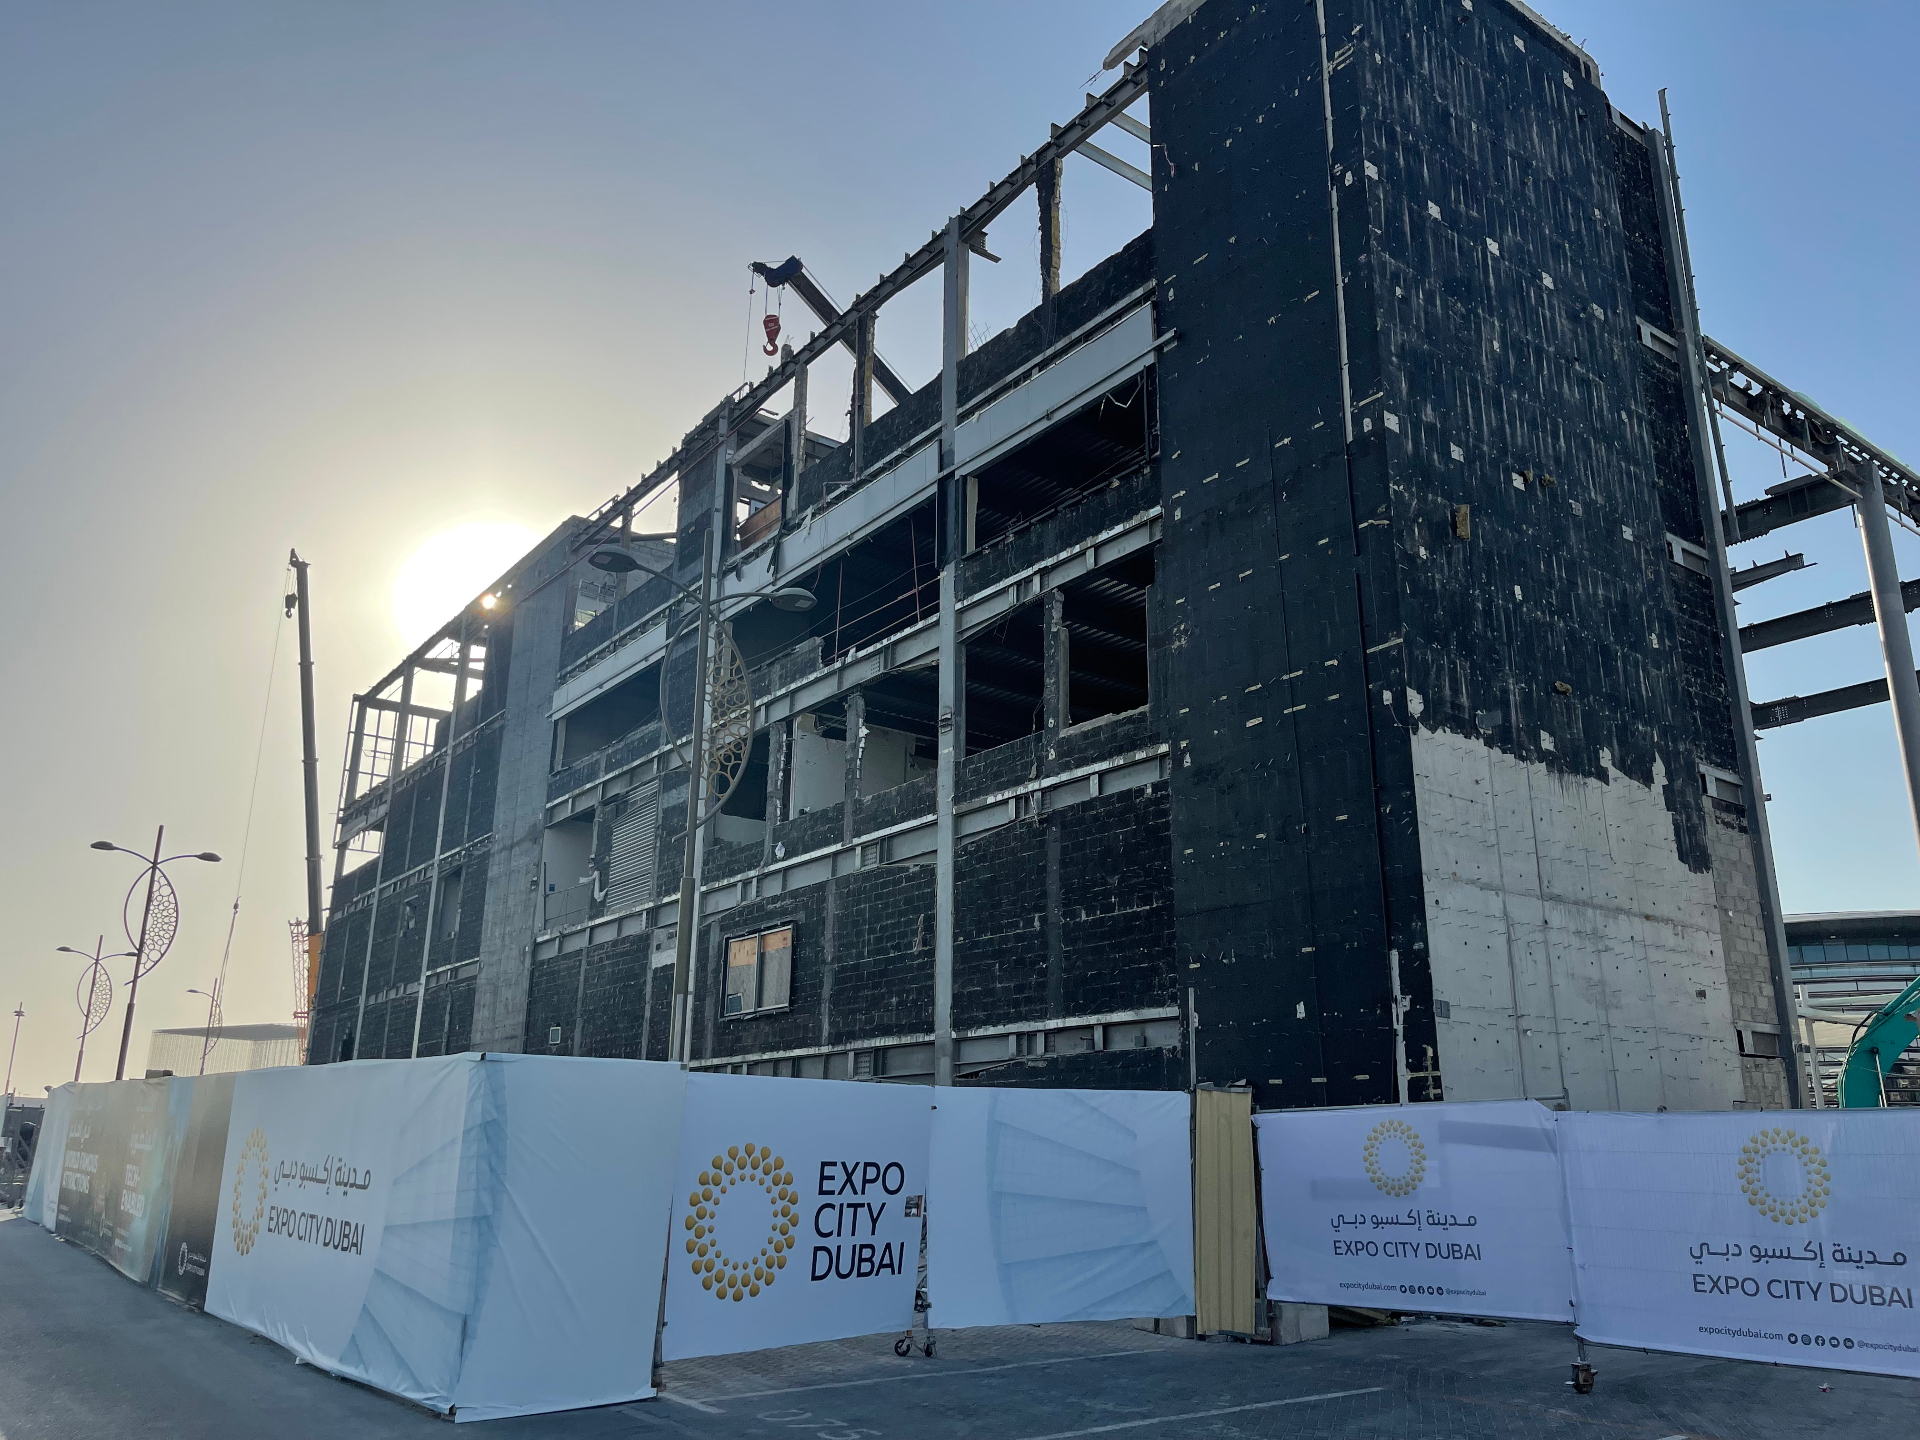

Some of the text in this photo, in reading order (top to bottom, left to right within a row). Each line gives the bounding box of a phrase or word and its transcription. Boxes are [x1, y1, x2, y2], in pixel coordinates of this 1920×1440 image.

[274, 1154, 371, 1196] مدينة إكسبو دبي
[818, 1161, 905, 1195] EXPO
[267, 1205, 365, 1256] EXPO CITY DUBAI
[814, 1202, 887, 1238] CITY
[1331, 1208, 1478, 1233] مدينة إكسبو دبي
[810, 1241, 905, 1282] DUBAI
[1333, 1240, 1483, 1261] EXPO CITY DUBAI
[1689, 1240, 1908, 1270] مدينة إكسبو دبي
[1339, 1281, 1487, 1297] expocitydubai.com @expocitydubai
[1692, 1273, 1915, 1310] EXPO CITY DUBAI
[1698, 1325, 1920, 1354] expocitydubai.com @expocitydubai
